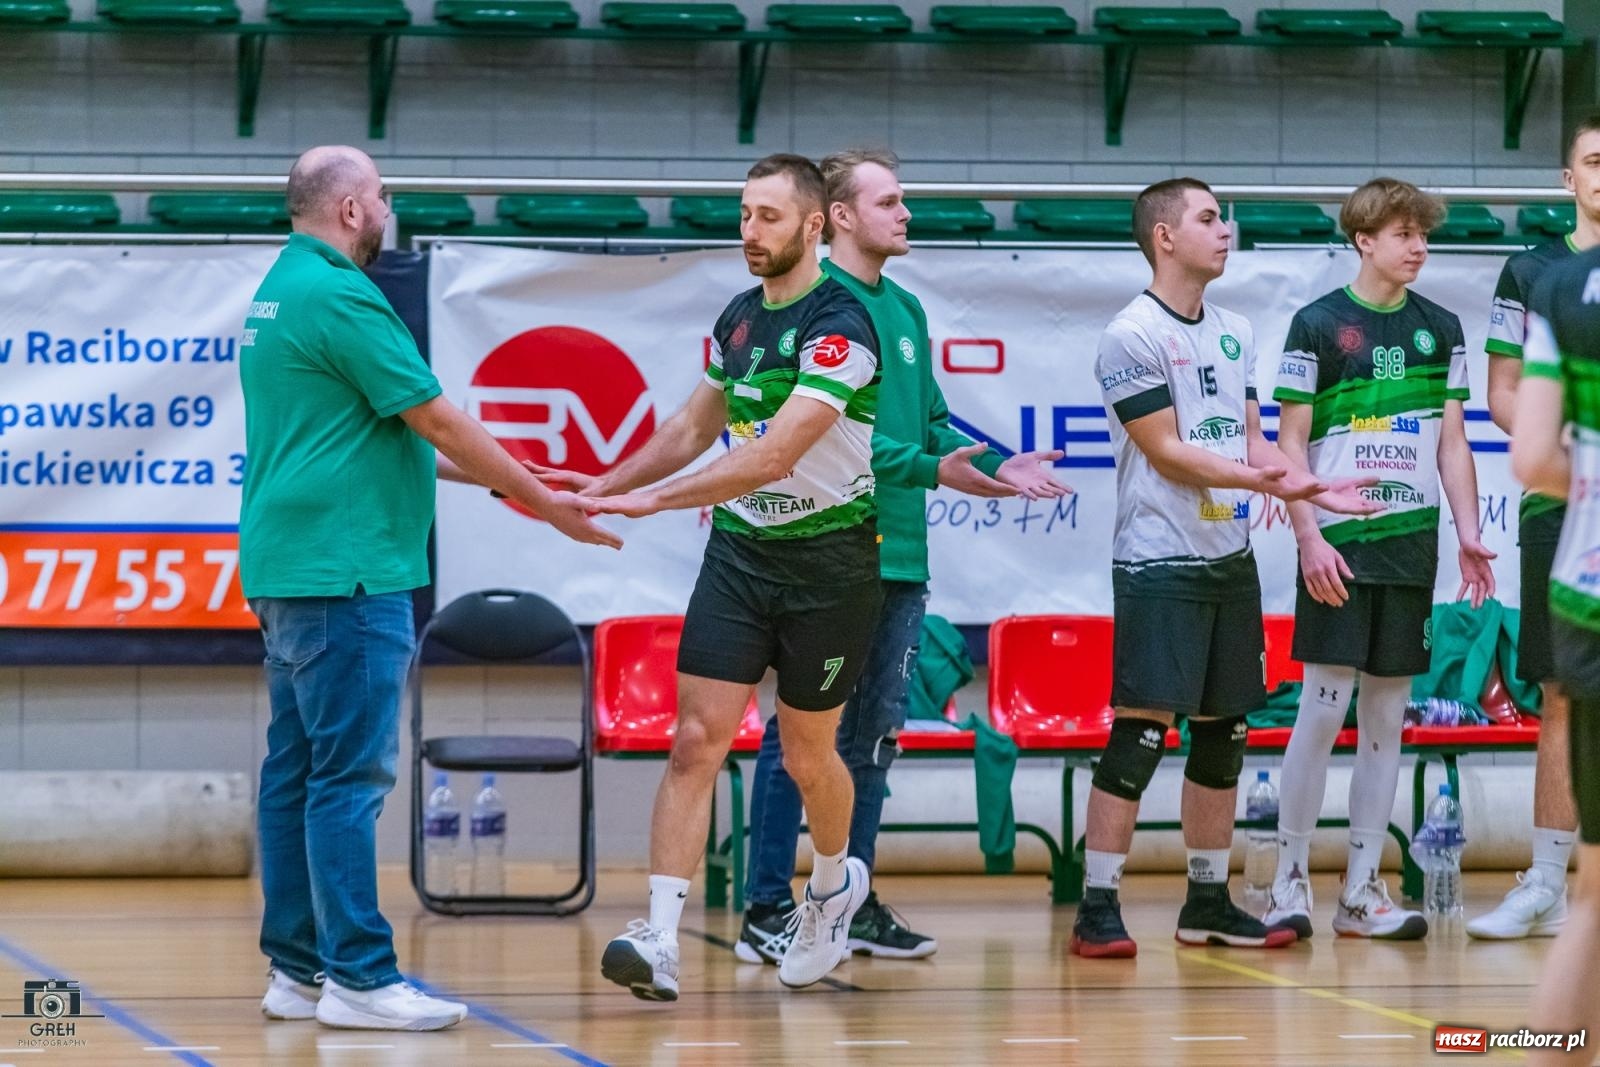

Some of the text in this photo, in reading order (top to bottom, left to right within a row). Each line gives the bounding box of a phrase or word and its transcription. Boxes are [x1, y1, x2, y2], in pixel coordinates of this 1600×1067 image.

[27, 328, 236, 363] Raciborzu
[1372, 346, 1405, 380] 98
[743, 347, 765, 383] 7
[1197, 364, 1218, 399] 15
[0, 393, 214, 436] pawska 69
[0, 449, 214, 485] ickiewicza
[1355, 445, 1417, 461] PIVEXIN
[1355, 460, 1417, 471] TECHNOLOGY
[24, 549, 98, 611] 77
[113, 549, 186, 611] 55
[203, 549, 251, 612] 7
[820, 656, 845, 691] 7
